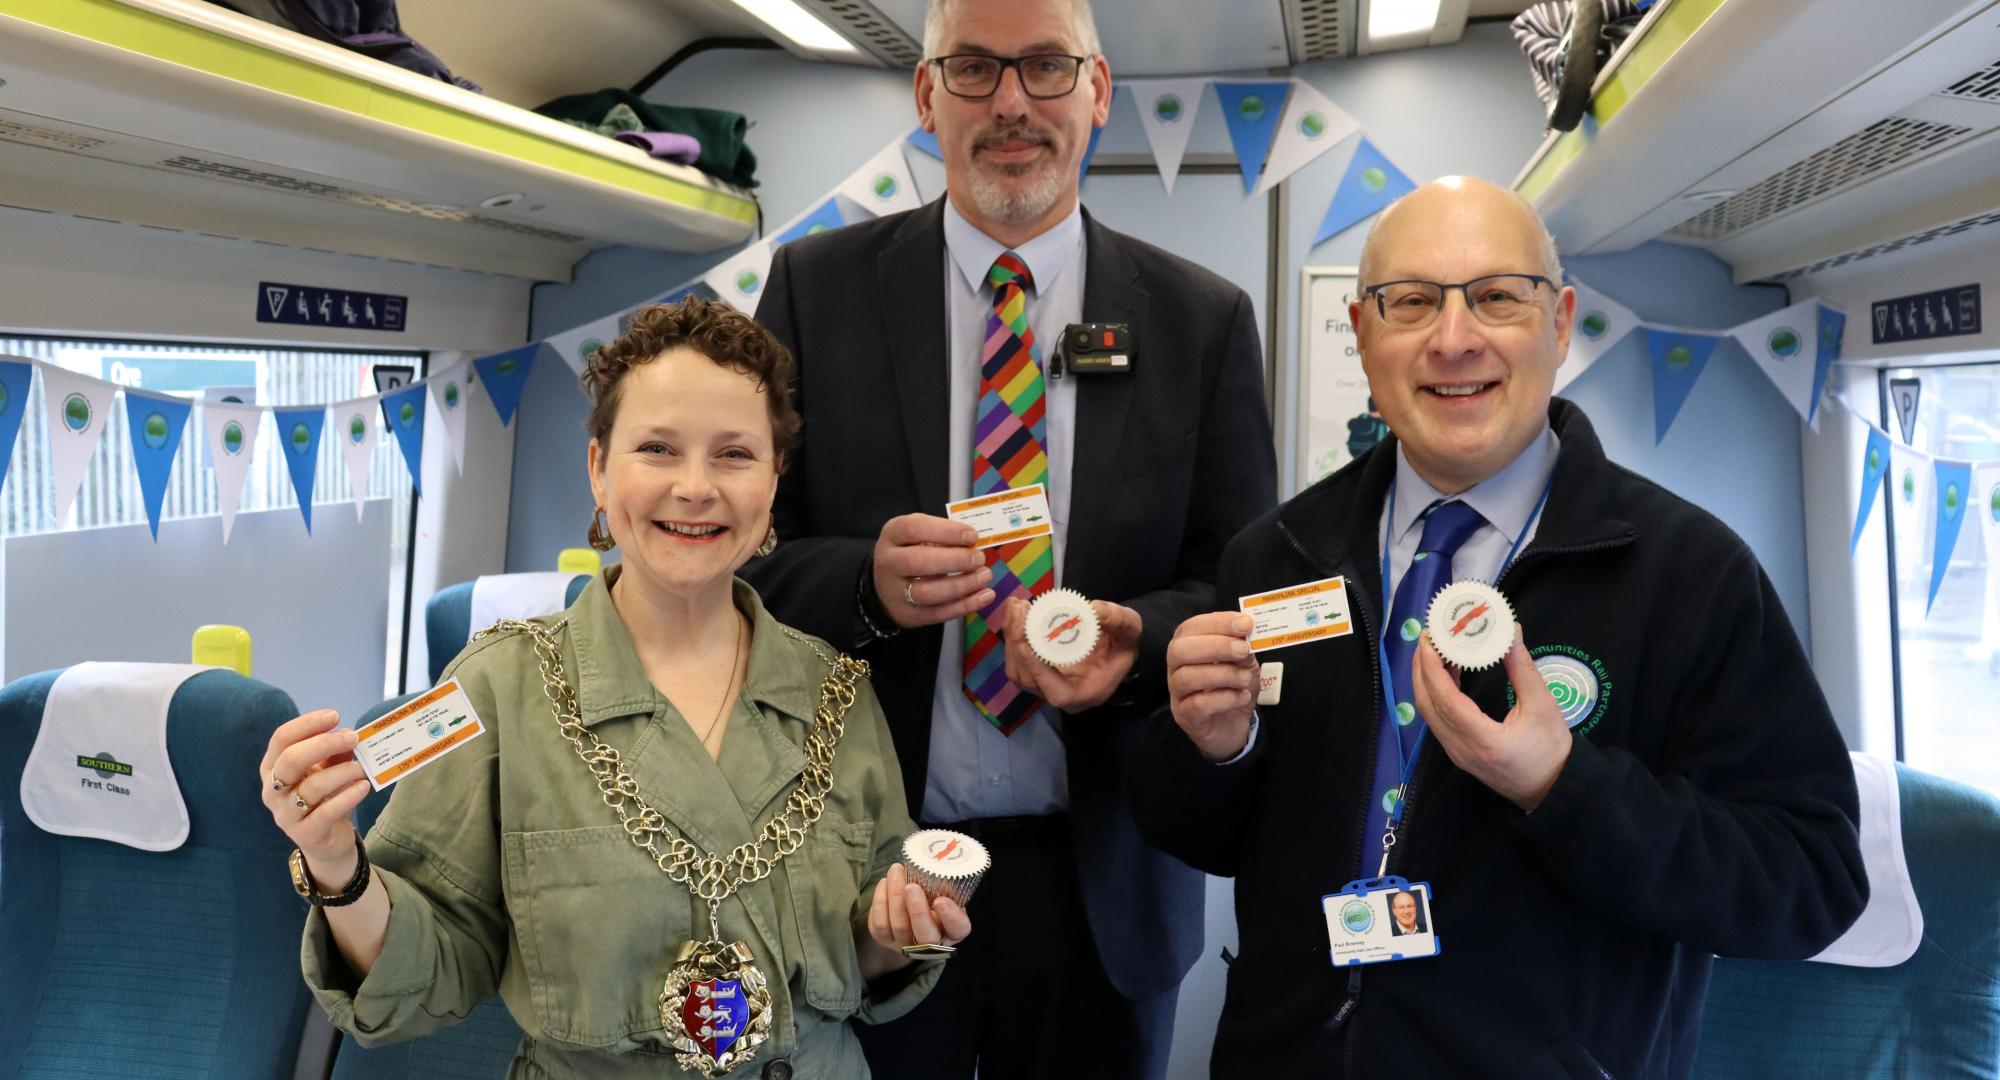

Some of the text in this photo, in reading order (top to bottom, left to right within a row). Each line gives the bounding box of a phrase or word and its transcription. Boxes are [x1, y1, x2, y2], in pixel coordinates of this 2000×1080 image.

[1325, 318, 1355, 333] Fin
[110, 361, 143, 388] Ore
[1902, 392, 1913, 426] P
[1529, 644, 1590, 661] munities
[1591, 658, 1609, 680] Rail
[373, 709, 408, 731] MARSHLINK
[410, 695, 434, 712] SPECIAL
[414, 735, 457, 762] ANNIVERSARY
[80, 758, 131, 774] SOUTHERN
[81, 778, 130, 796] First Class
